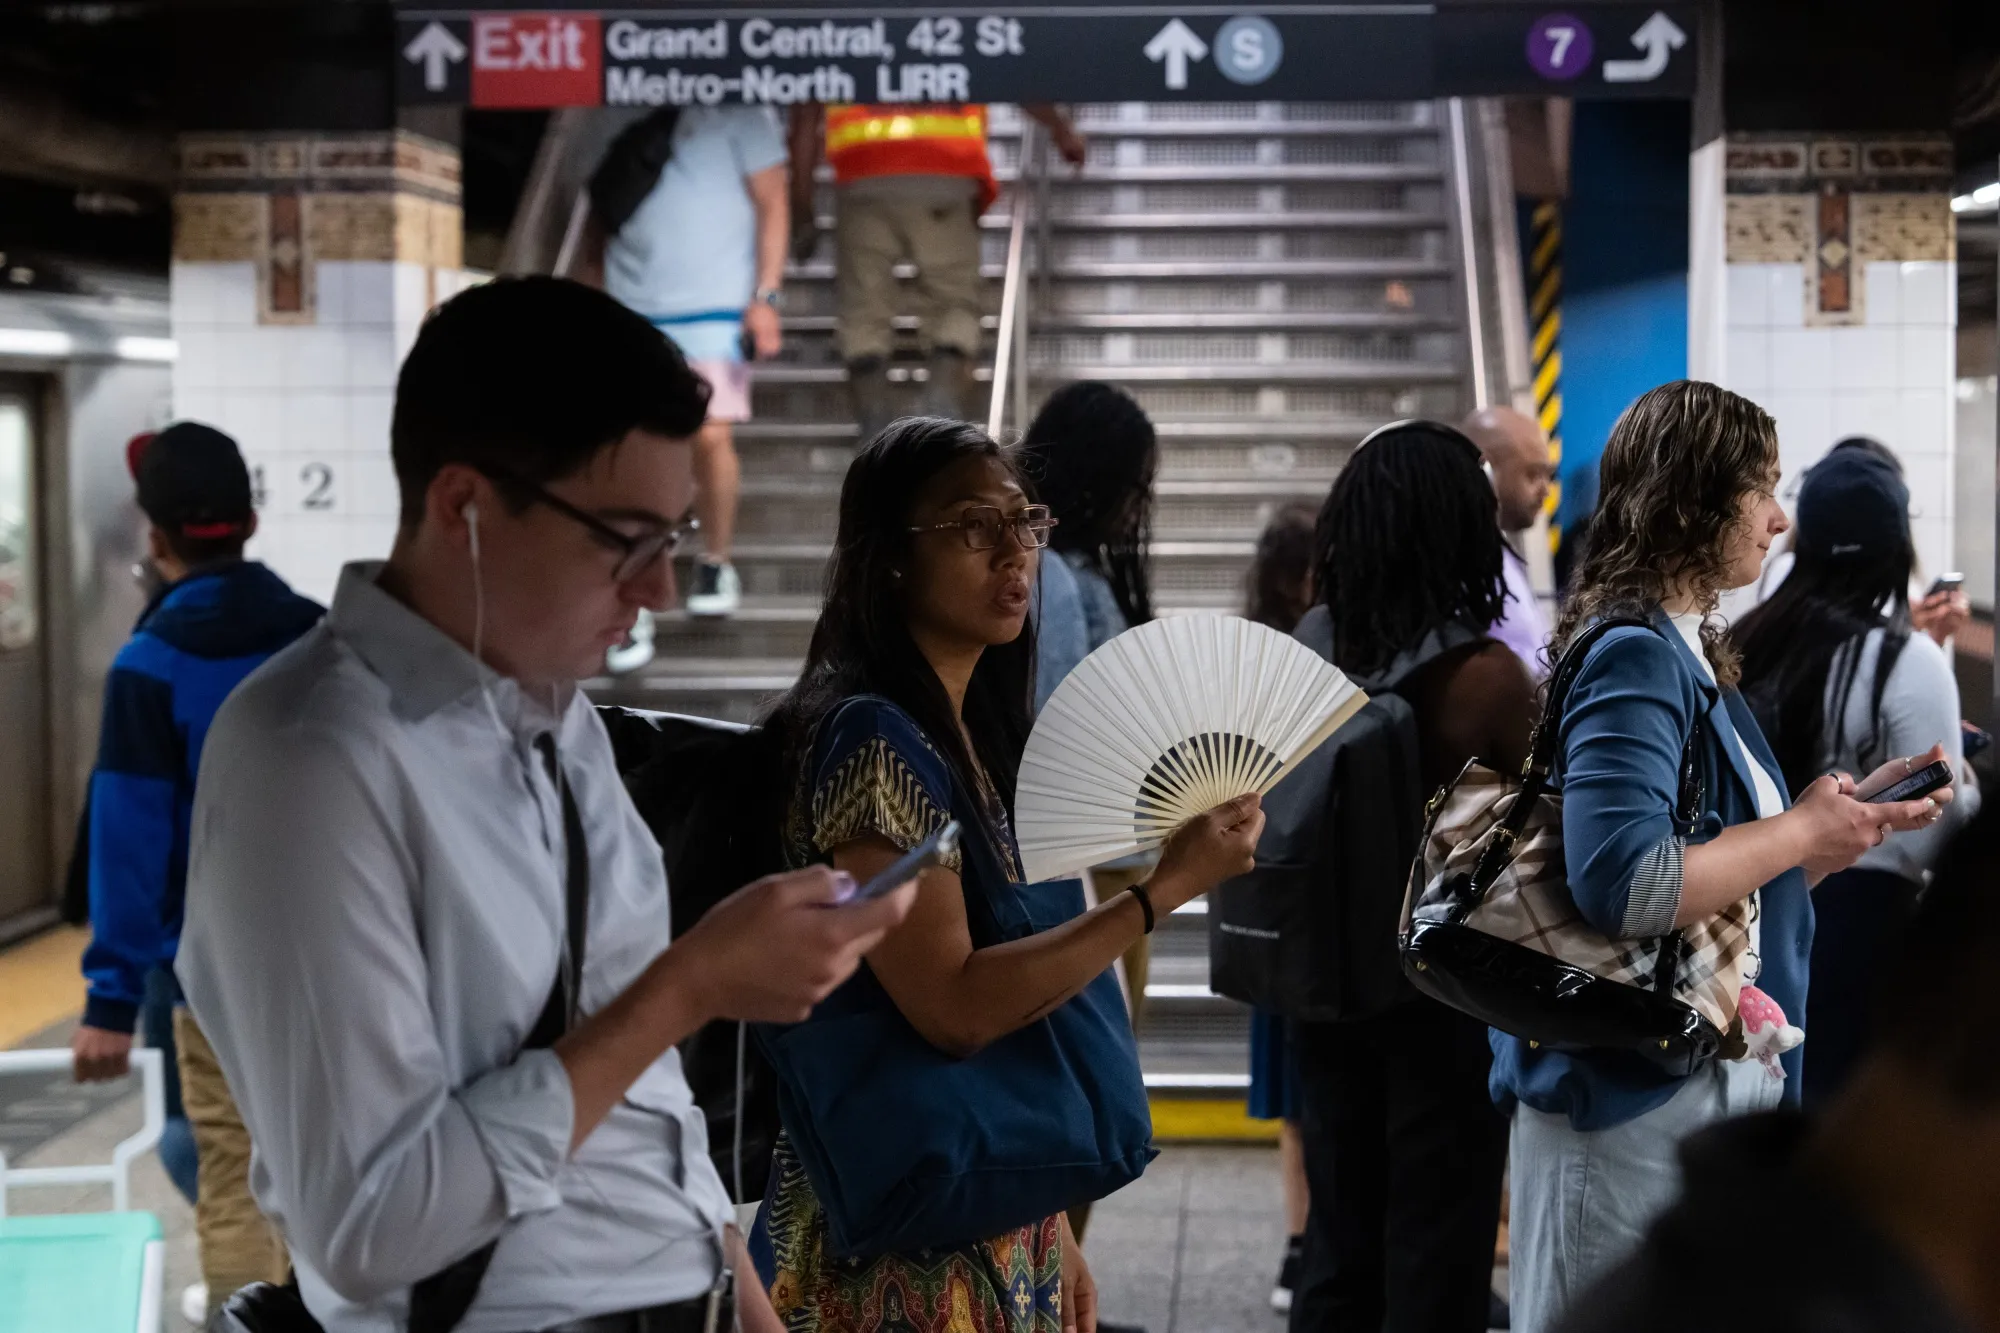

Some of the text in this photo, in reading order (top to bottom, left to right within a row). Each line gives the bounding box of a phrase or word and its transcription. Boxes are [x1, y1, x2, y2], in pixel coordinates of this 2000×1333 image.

[474, 16, 584, 69] Exit
[606, 15, 1023, 61] Grand Central, 42 St
[1231, 28, 1265, 70] S
[1544, 27, 1576, 68] 7
[606, 63, 969, 104] Metro-North LIRR
